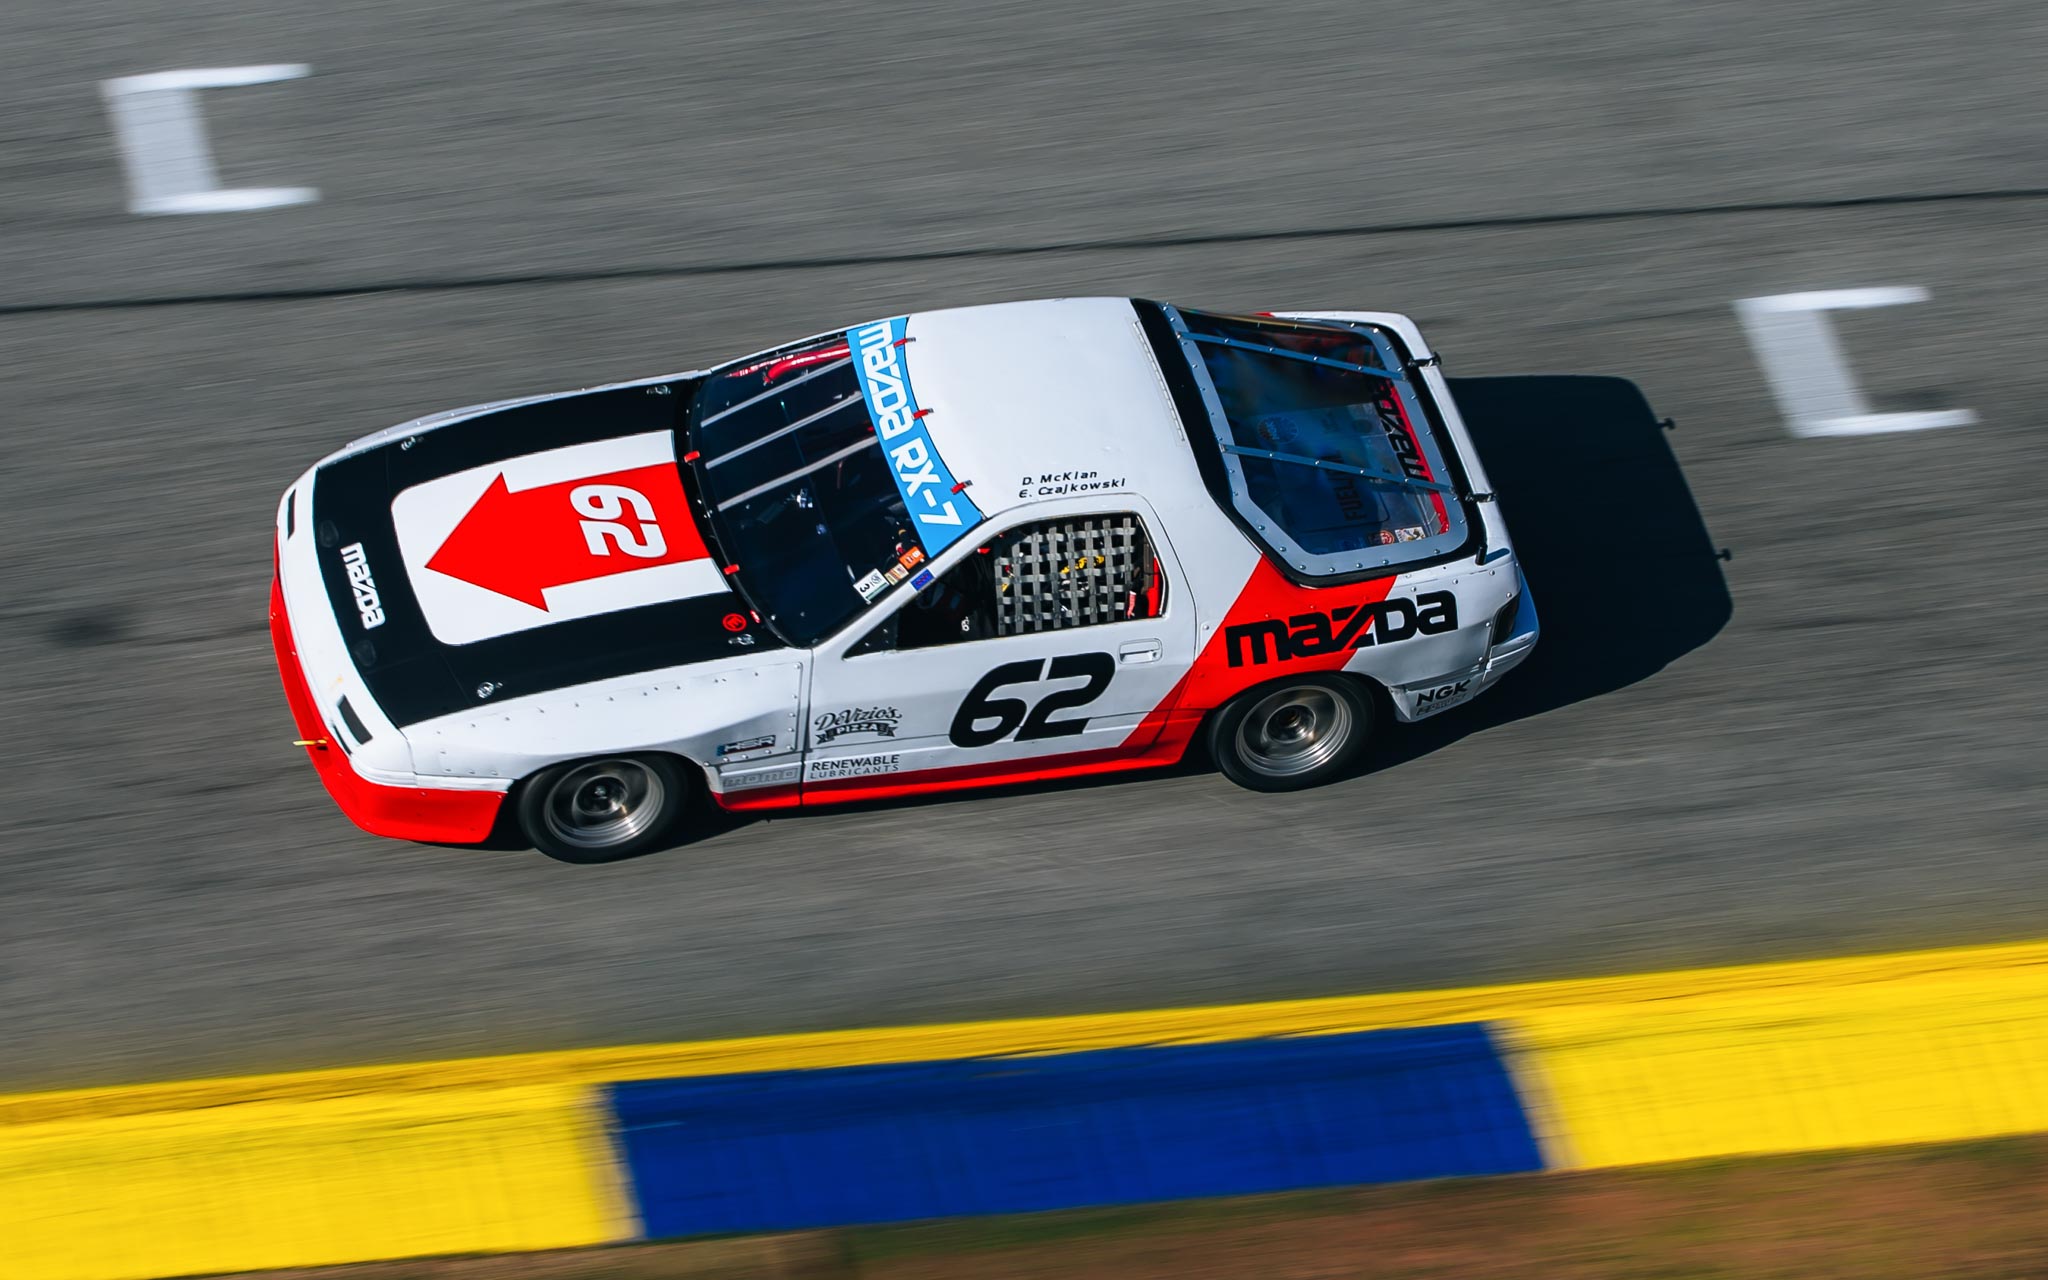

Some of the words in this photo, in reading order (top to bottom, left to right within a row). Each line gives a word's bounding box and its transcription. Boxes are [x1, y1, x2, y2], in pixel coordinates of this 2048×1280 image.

[889, 437, 963, 526] RX-7
[569, 484, 668, 558] 62
[340, 541, 386, 630] mazda
[1224, 589, 1459, 669] mazda
[838, 722, 878, 734] PIZZA
[949, 651, 1116, 748] 62
[1415, 678, 1472, 707] NGK
[810, 764, 899, 780] LUBRICANTS
[811, 754, 900, 772] RENEWABLE
